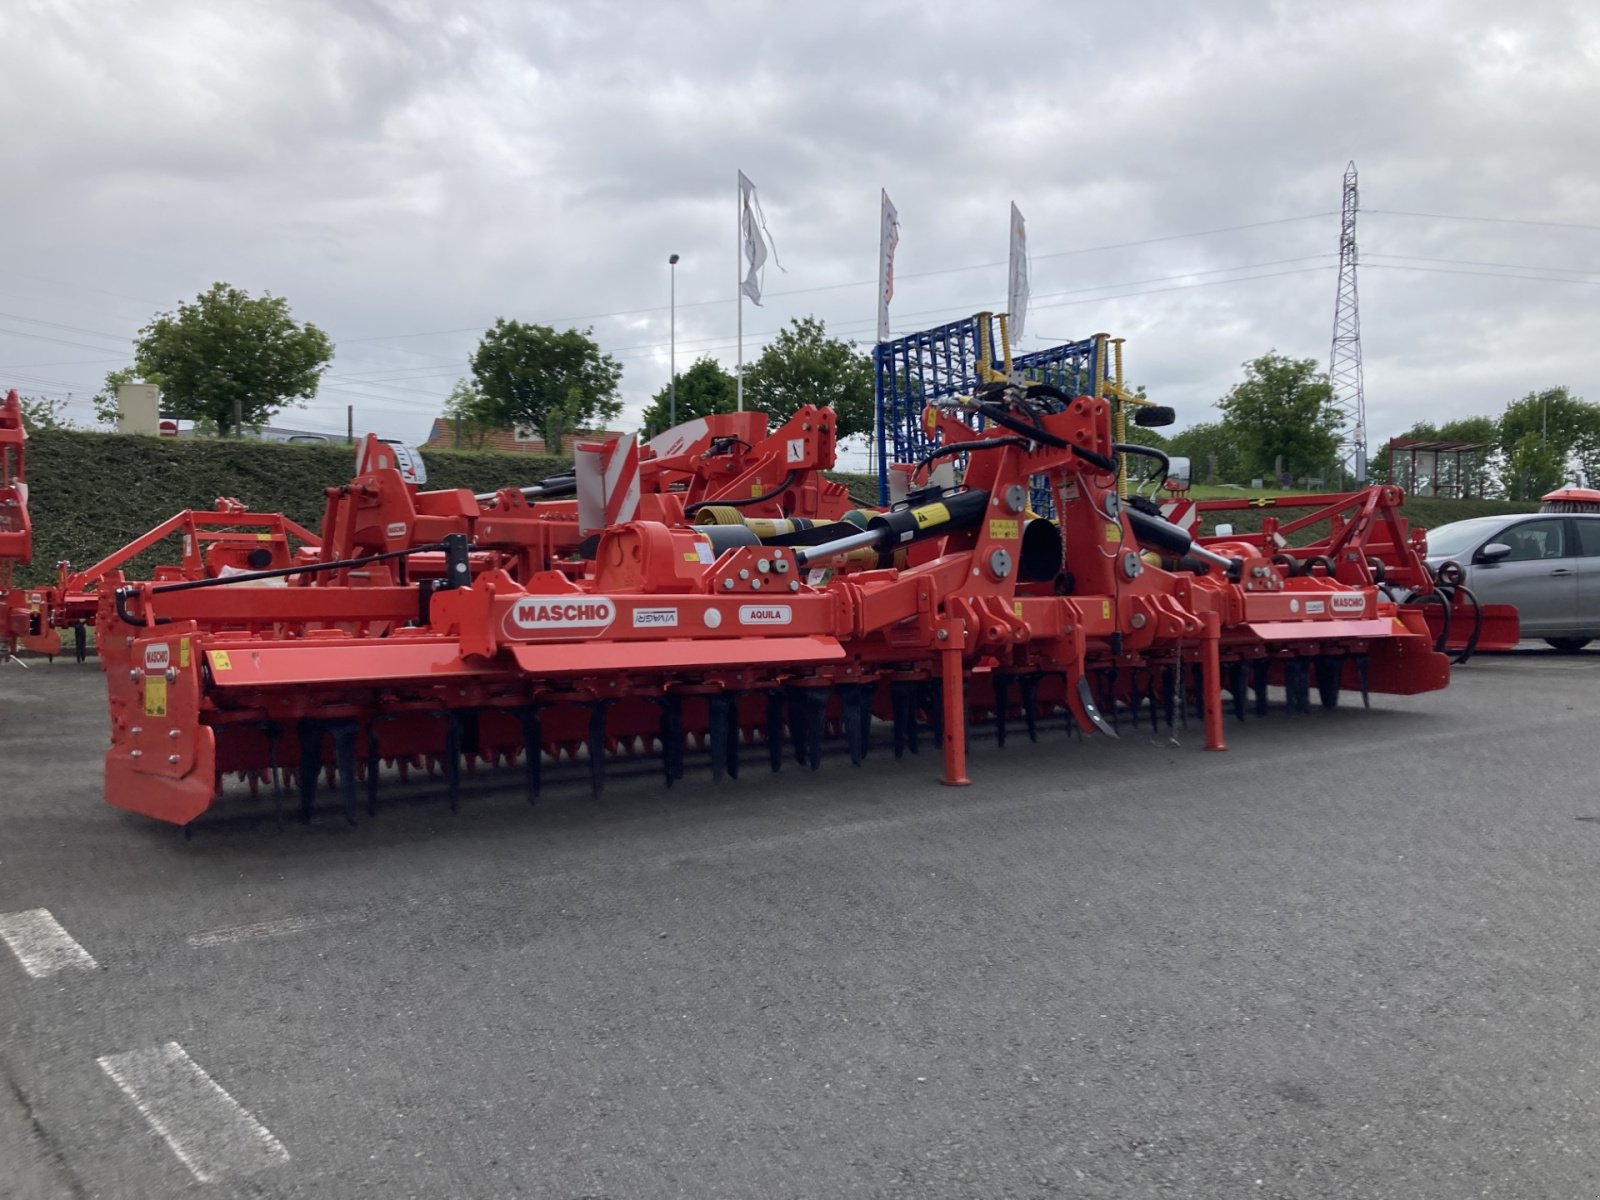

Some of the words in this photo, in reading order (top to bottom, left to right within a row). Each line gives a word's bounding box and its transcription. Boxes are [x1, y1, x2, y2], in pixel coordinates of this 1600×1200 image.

[1333, 598, 1363, 607] MASCHIO
[519, 605, 609, 622] MASCHIO
[751, 611, 781, 619] AQUILA
[635, 614, 675, 624] VIVAGRI
[146, 651, 168, 663] MASCHIO
